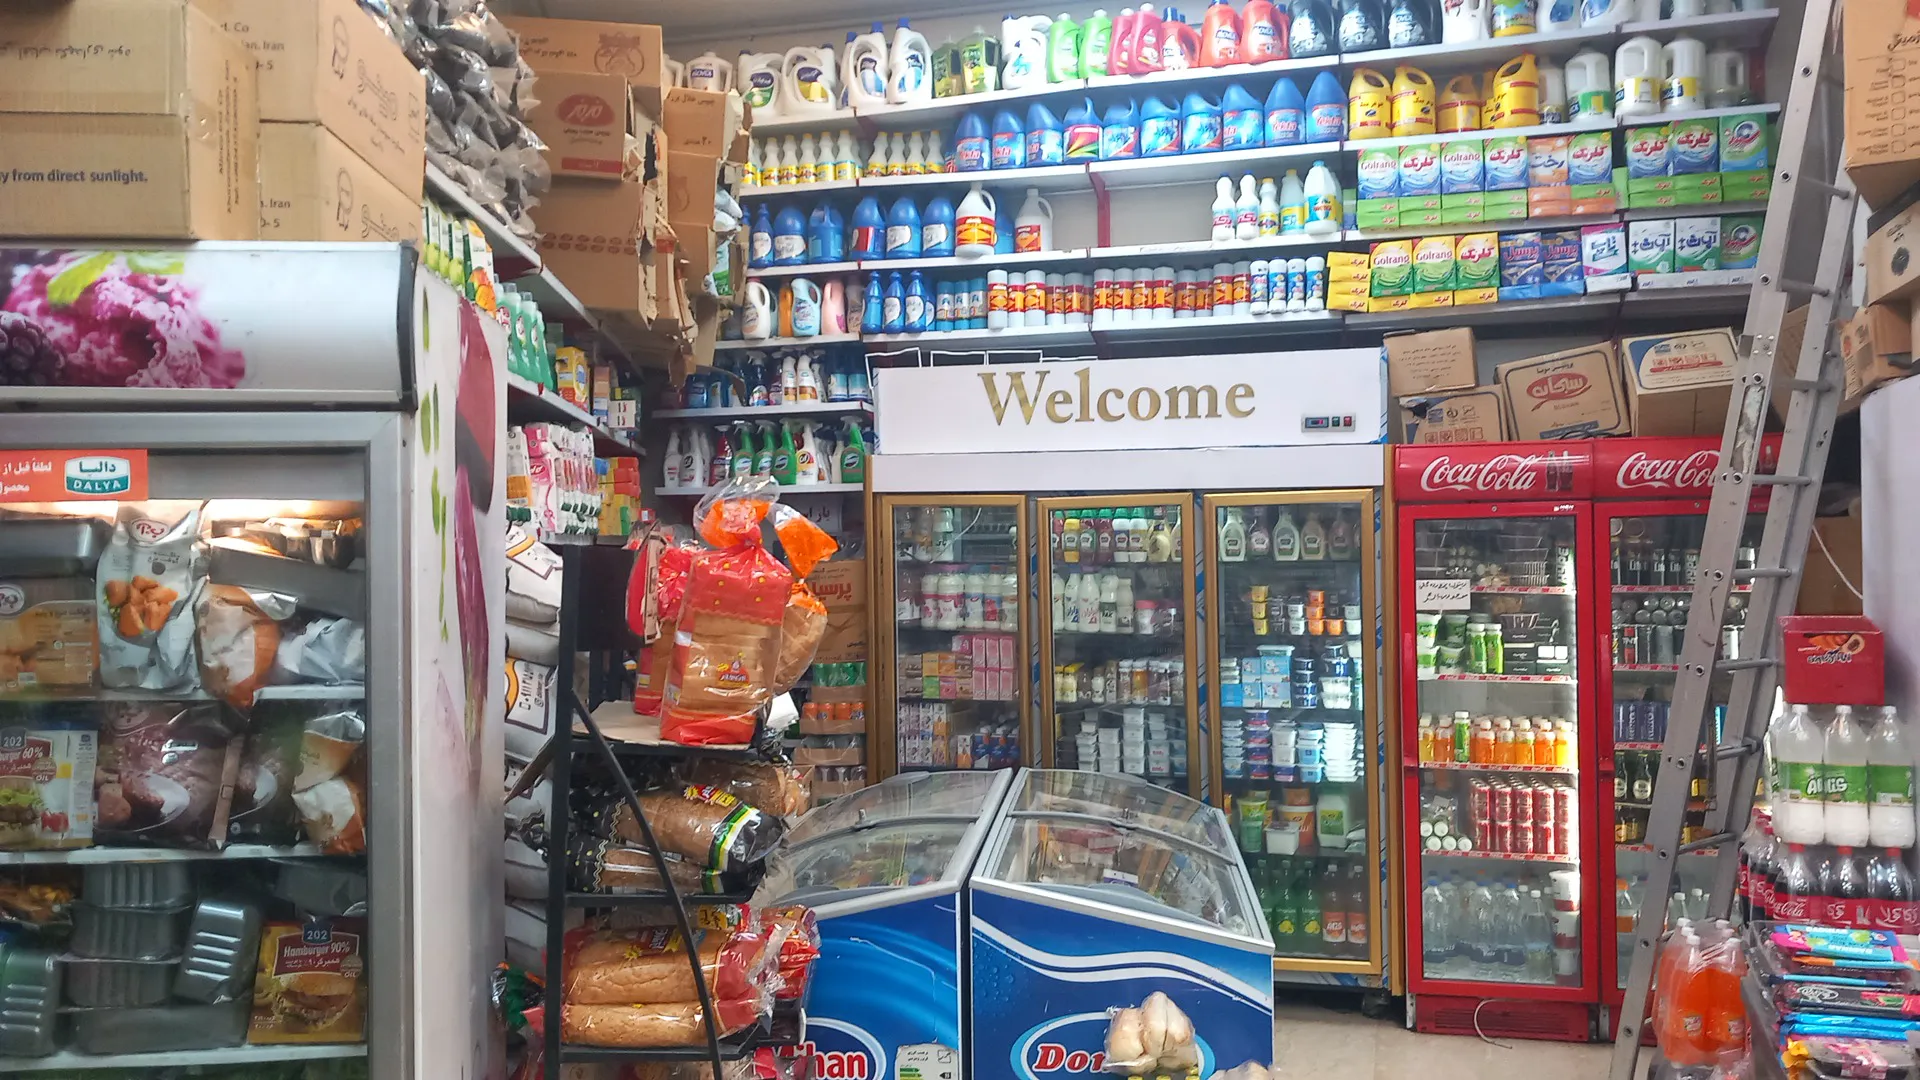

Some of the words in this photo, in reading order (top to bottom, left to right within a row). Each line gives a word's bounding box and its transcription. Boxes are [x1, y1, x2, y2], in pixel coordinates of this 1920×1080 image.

[1632, 138, 1669, 156] گلرنگ
[1676, 130, 1714, 148] گلرنگ
[1489, 147, 1524, 164] گلرنگ
[1572, 144, 1608, 163] گلرنگ
[1403, 155, 1438, 172] گلرنگ
[12, 168, 44, 182] from
[47, 168, 86, 182] direct
[90, 168, 148, 185] sunlight.
[1373, 254, 1410, 267] Golrang
[1415, 249, 1453, 262] Golrang
[1460, 247, 1495, 263] گلرنگ
[977, 367, 1257, 427] Welcome
[2, 461, 13, 475] از
[13, 462, 30, 474] قبل
[79, 460, 117, 478] دالیا
[1421, 453, 1541, 492] Coca-Cola
[74, 479, 121, 491] DALYA
[3, 736, 22, 748] 202
[22, 746, 44, 759] 60%
[307, 930, 328, 940] 202
[284, 945, 330, 958] Hamburger
[331, 941, 350, 953] 90%
